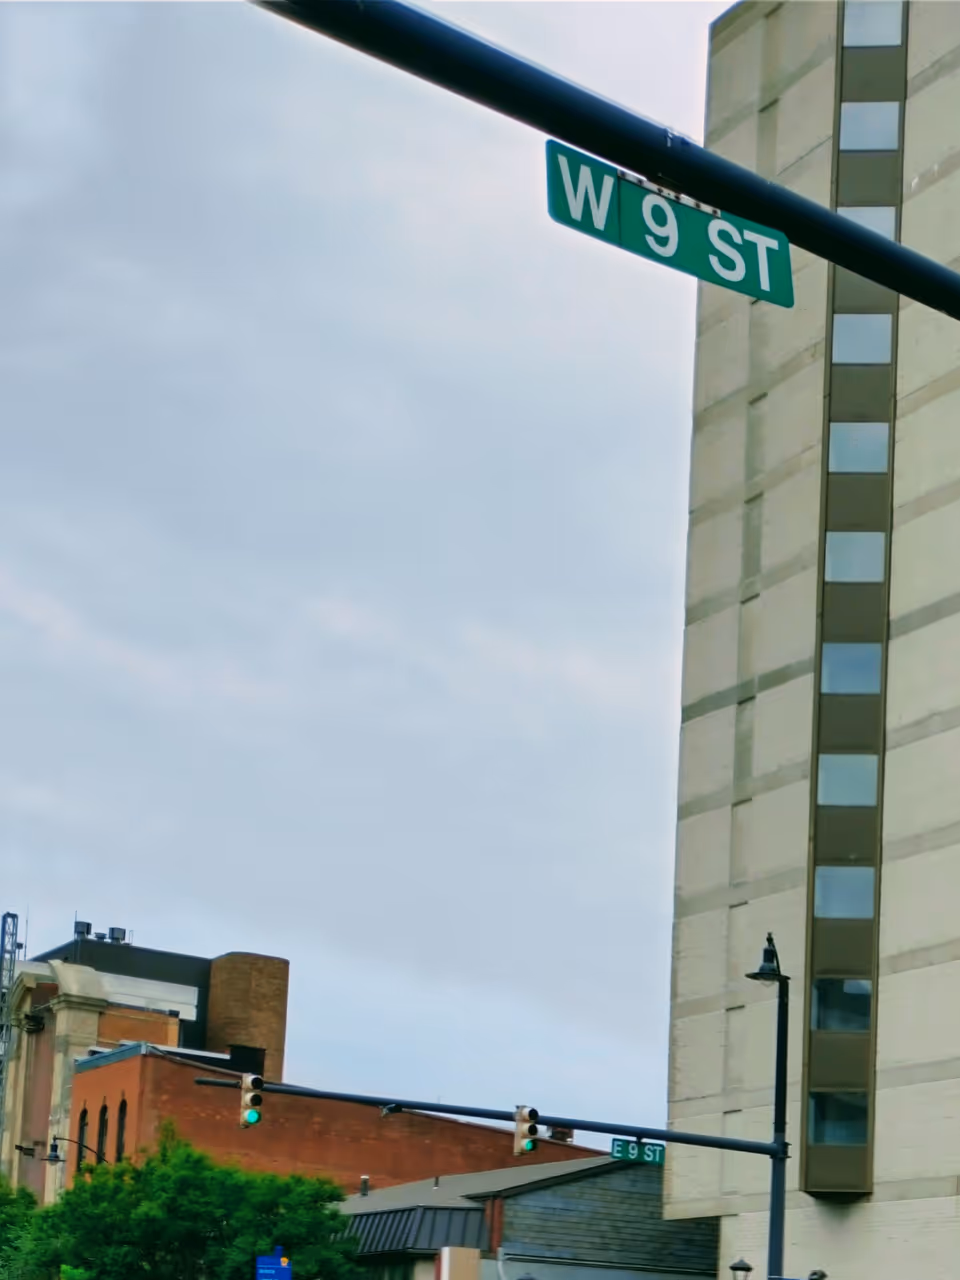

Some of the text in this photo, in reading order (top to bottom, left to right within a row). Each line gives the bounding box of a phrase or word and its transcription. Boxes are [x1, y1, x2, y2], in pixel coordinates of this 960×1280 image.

[557, 153, 779, 292] W 9 ST
[613, 1140, 663, 1162] E 9 ST
